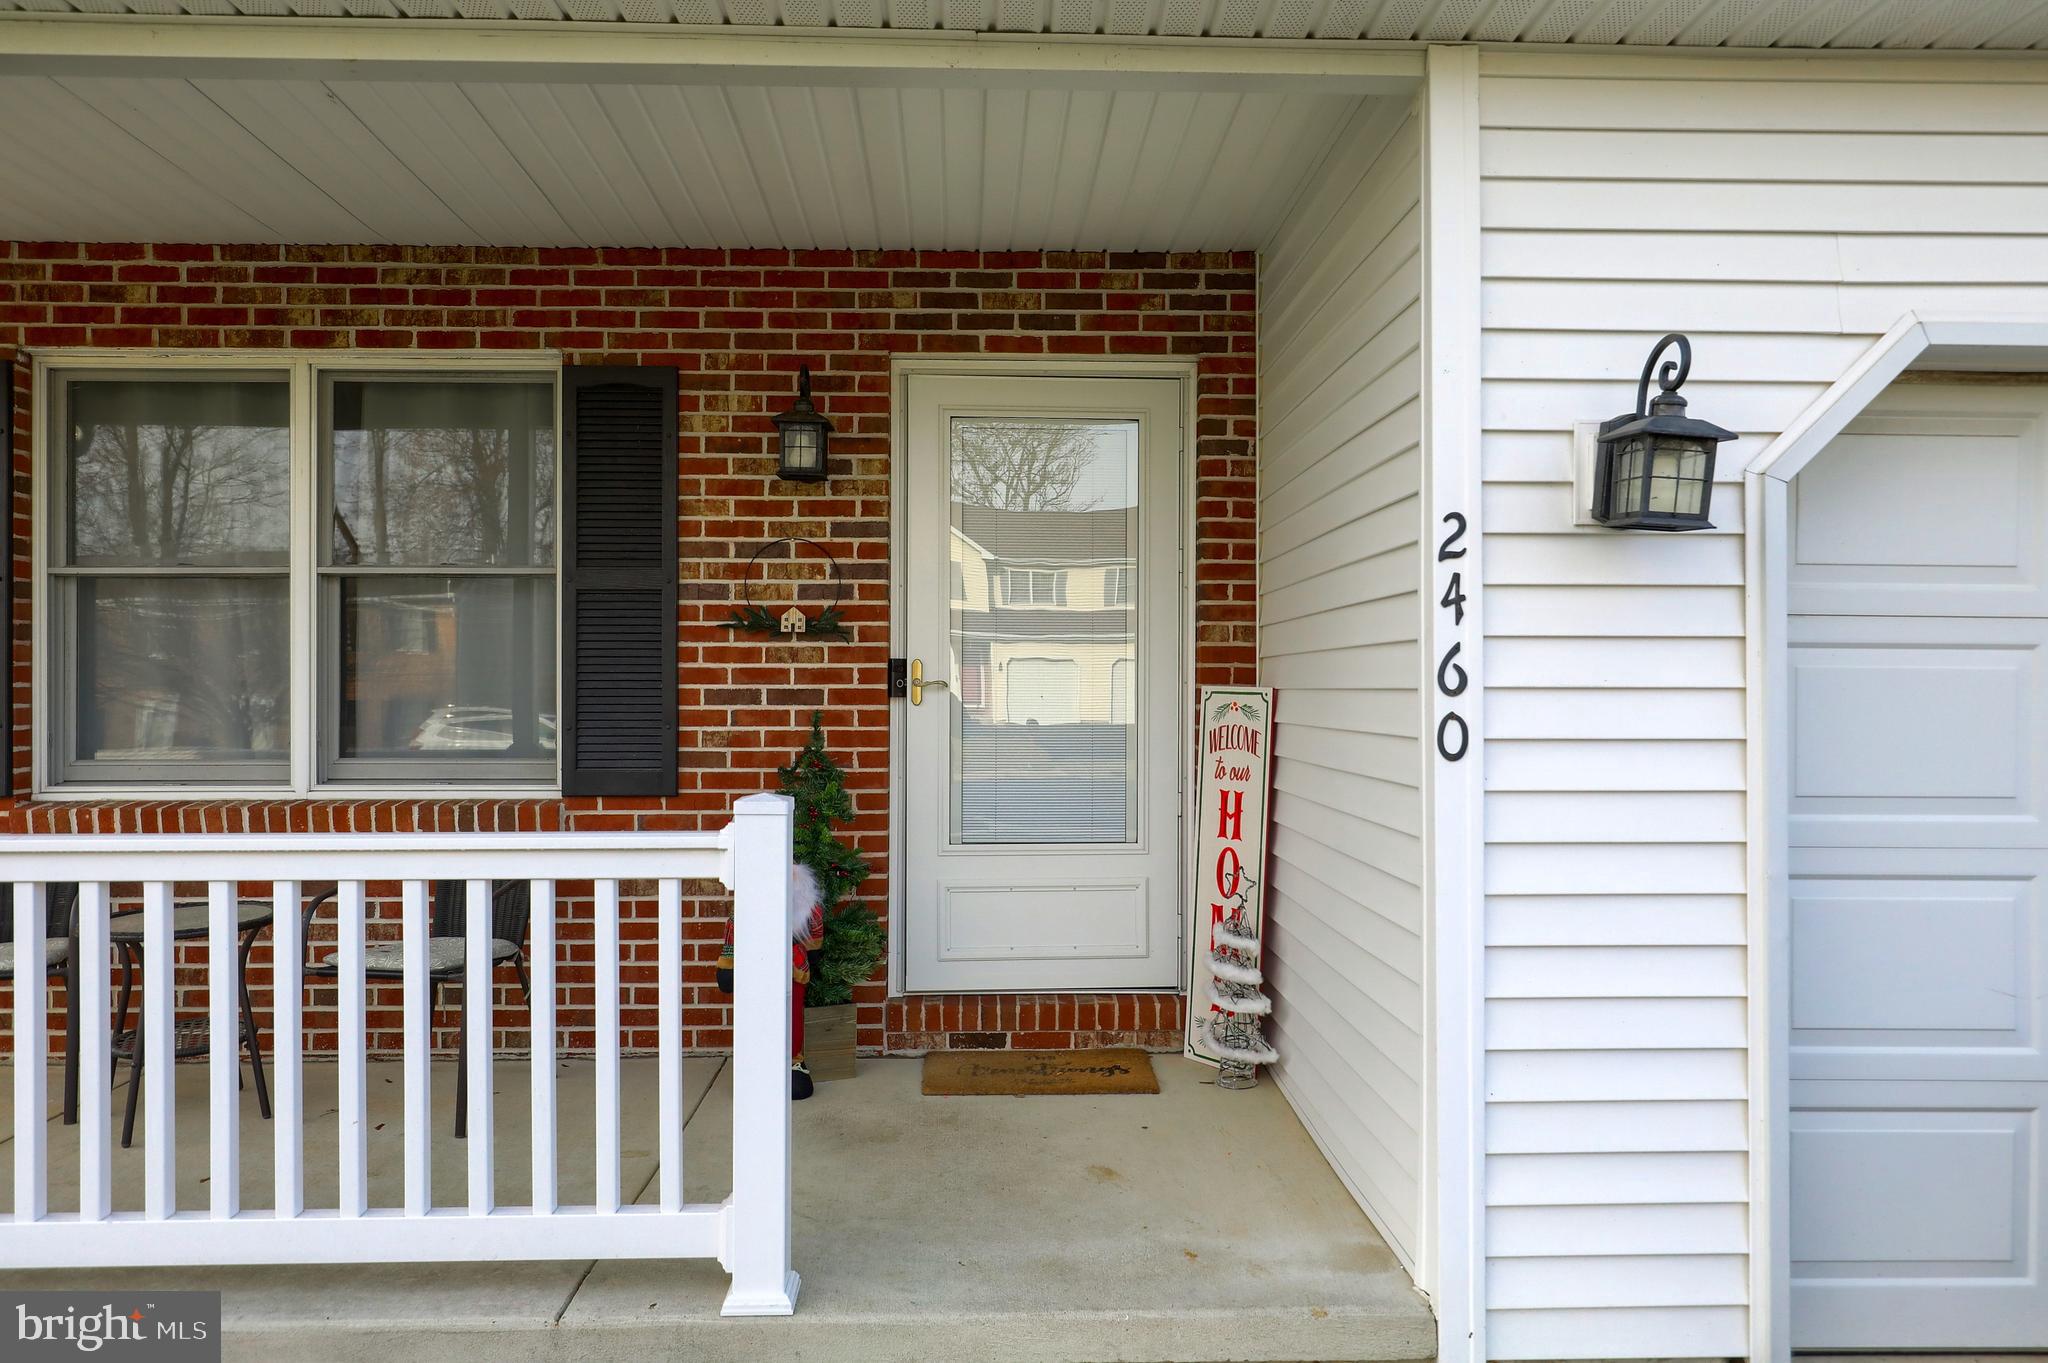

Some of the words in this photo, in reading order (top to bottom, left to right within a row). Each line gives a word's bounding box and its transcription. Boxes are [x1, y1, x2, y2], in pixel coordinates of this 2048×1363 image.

[1437, 511, 1469, 762] 2460
[1209, 724, 1262, 759] WELCOME
[1214, 756, 1227, 780] to
[1229, 765, 1251, 782] our
